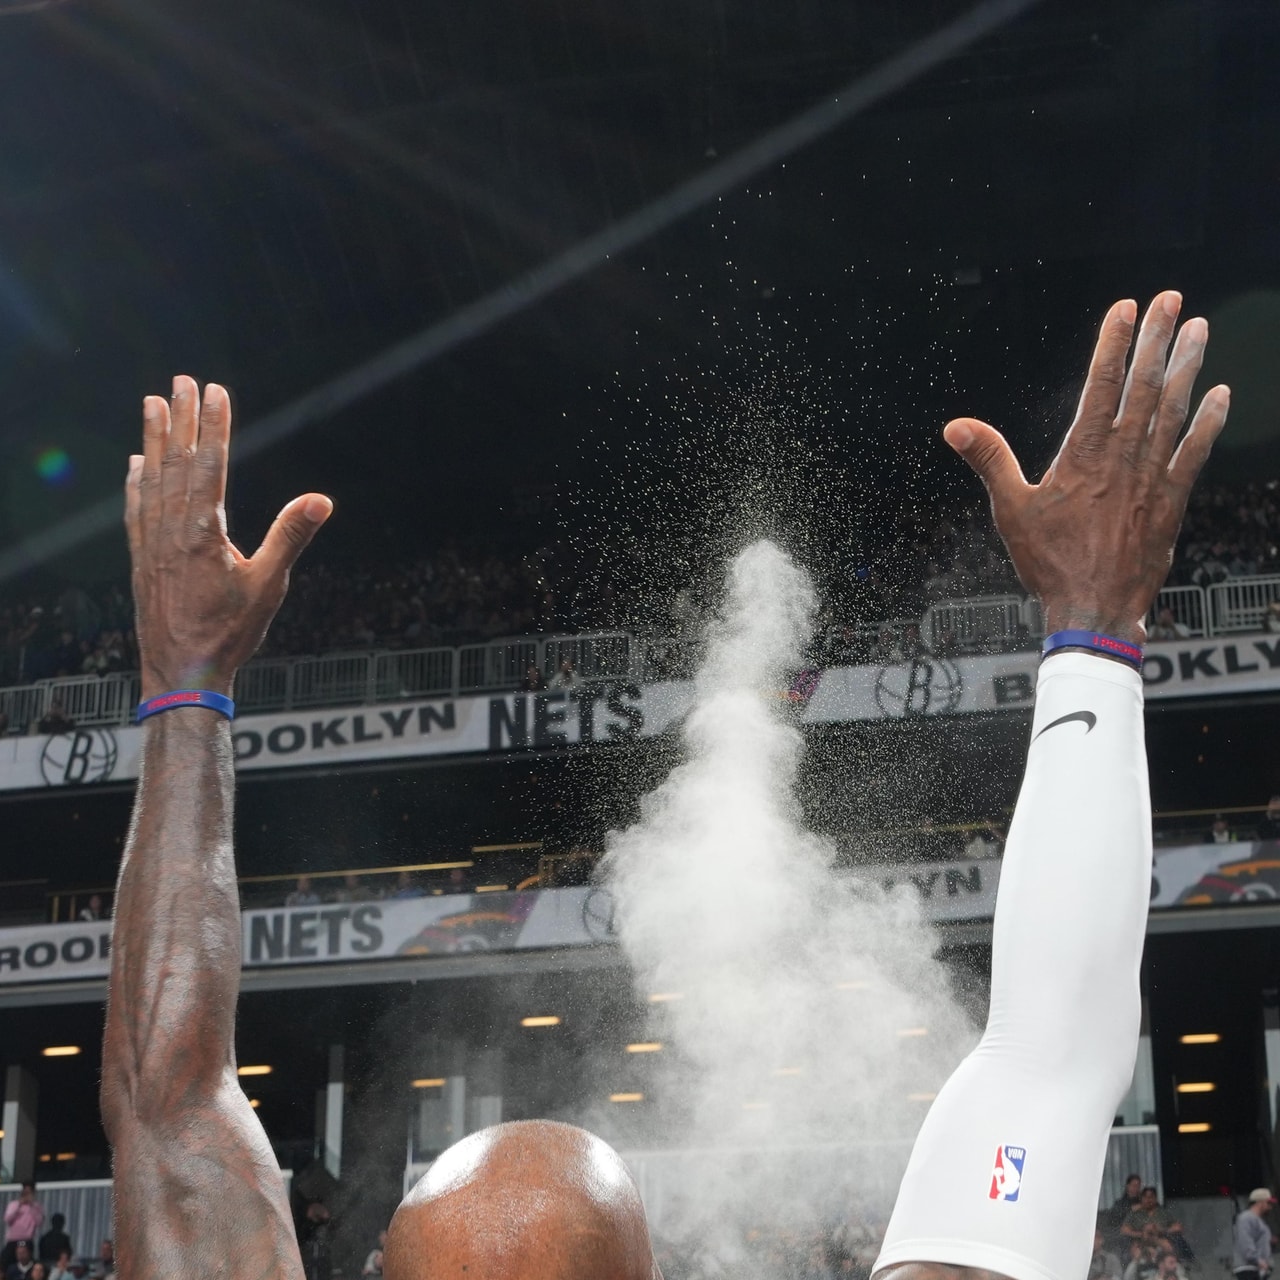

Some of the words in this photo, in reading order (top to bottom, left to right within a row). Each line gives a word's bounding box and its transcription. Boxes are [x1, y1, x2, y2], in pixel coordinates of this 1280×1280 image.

[232, 702, 456, 758] OOKLYN
[488, 684, 637, 754] NETS
[249, 906, 378, 961] NETS
[1006, 1147, 1024, 1160] NBA
